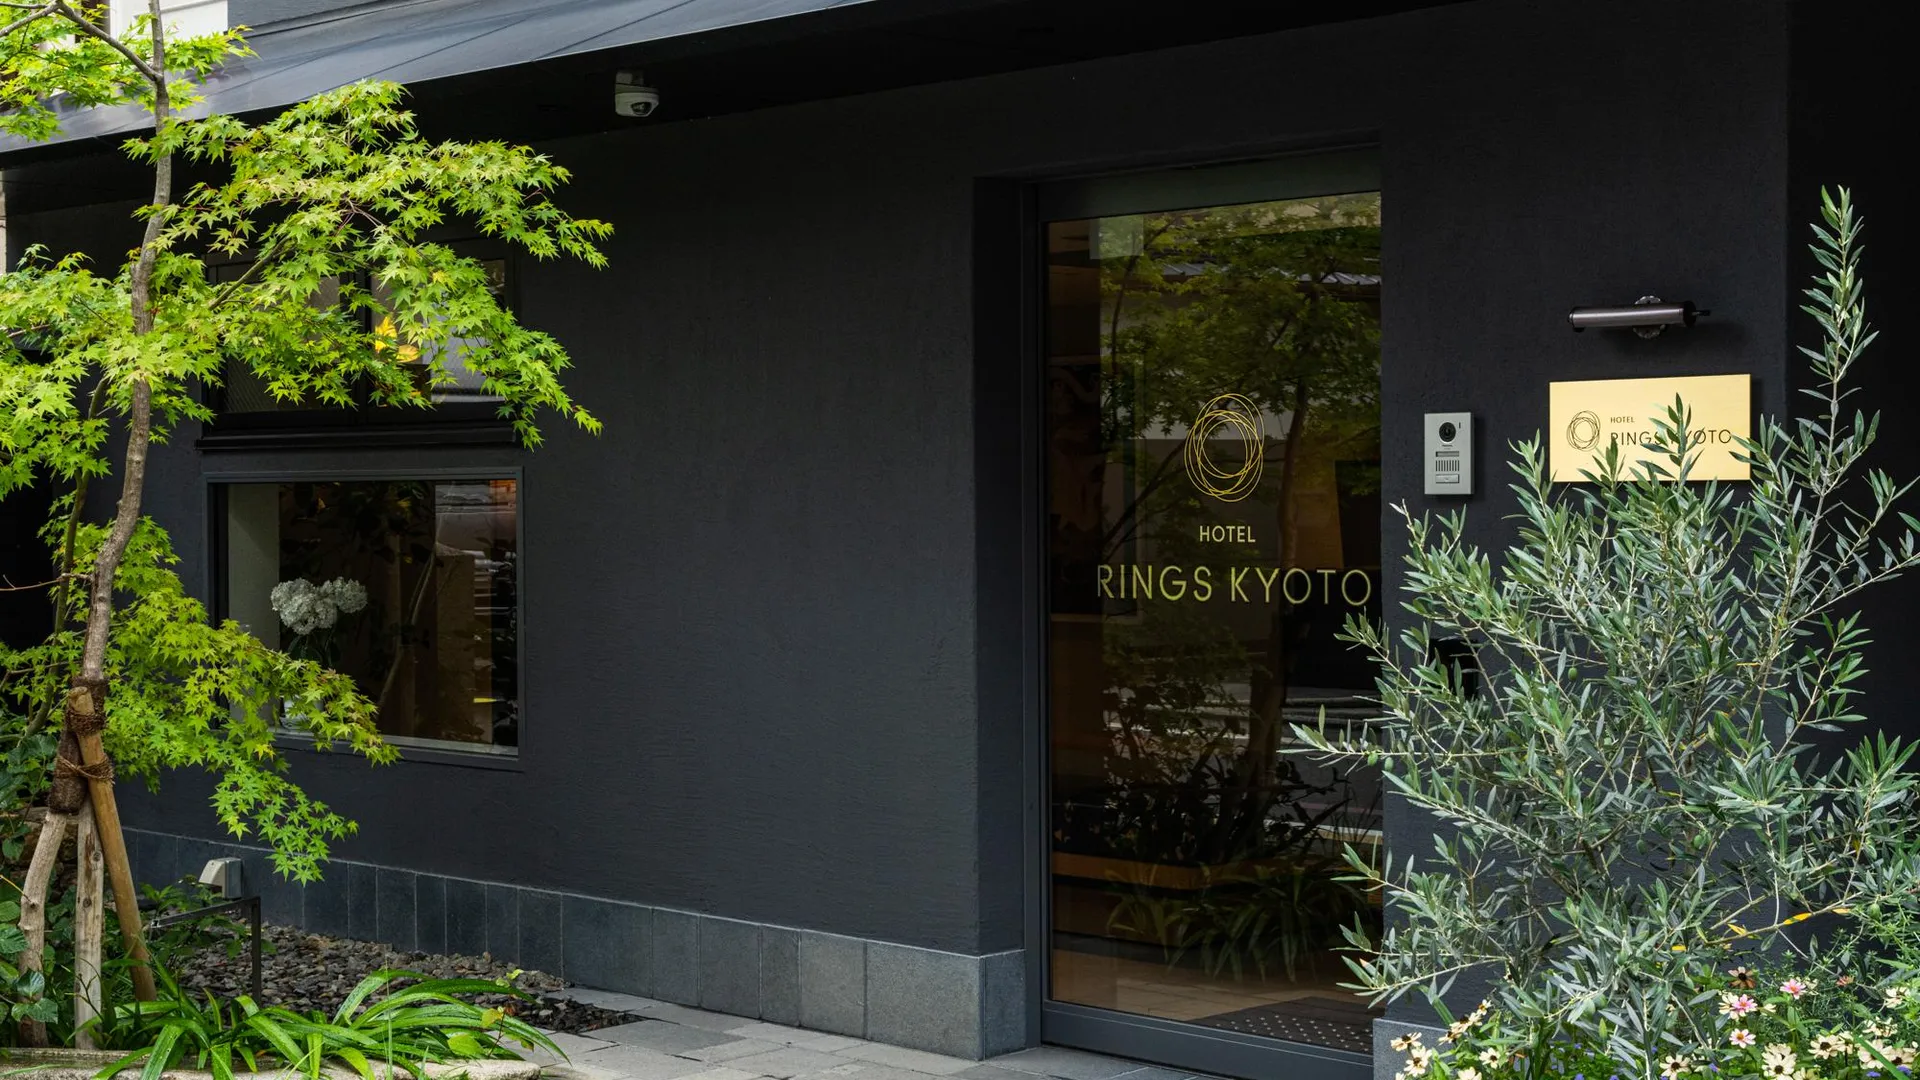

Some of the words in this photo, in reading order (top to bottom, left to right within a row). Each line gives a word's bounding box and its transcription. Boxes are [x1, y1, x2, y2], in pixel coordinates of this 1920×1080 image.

[1610, 416, 1635, 424] HOTEL
[1199, 525, 1256, 543] HOTEL
[1096, 564, 1213, 603] RINGS
[1230, 566, 1372, 607] KYOTO
